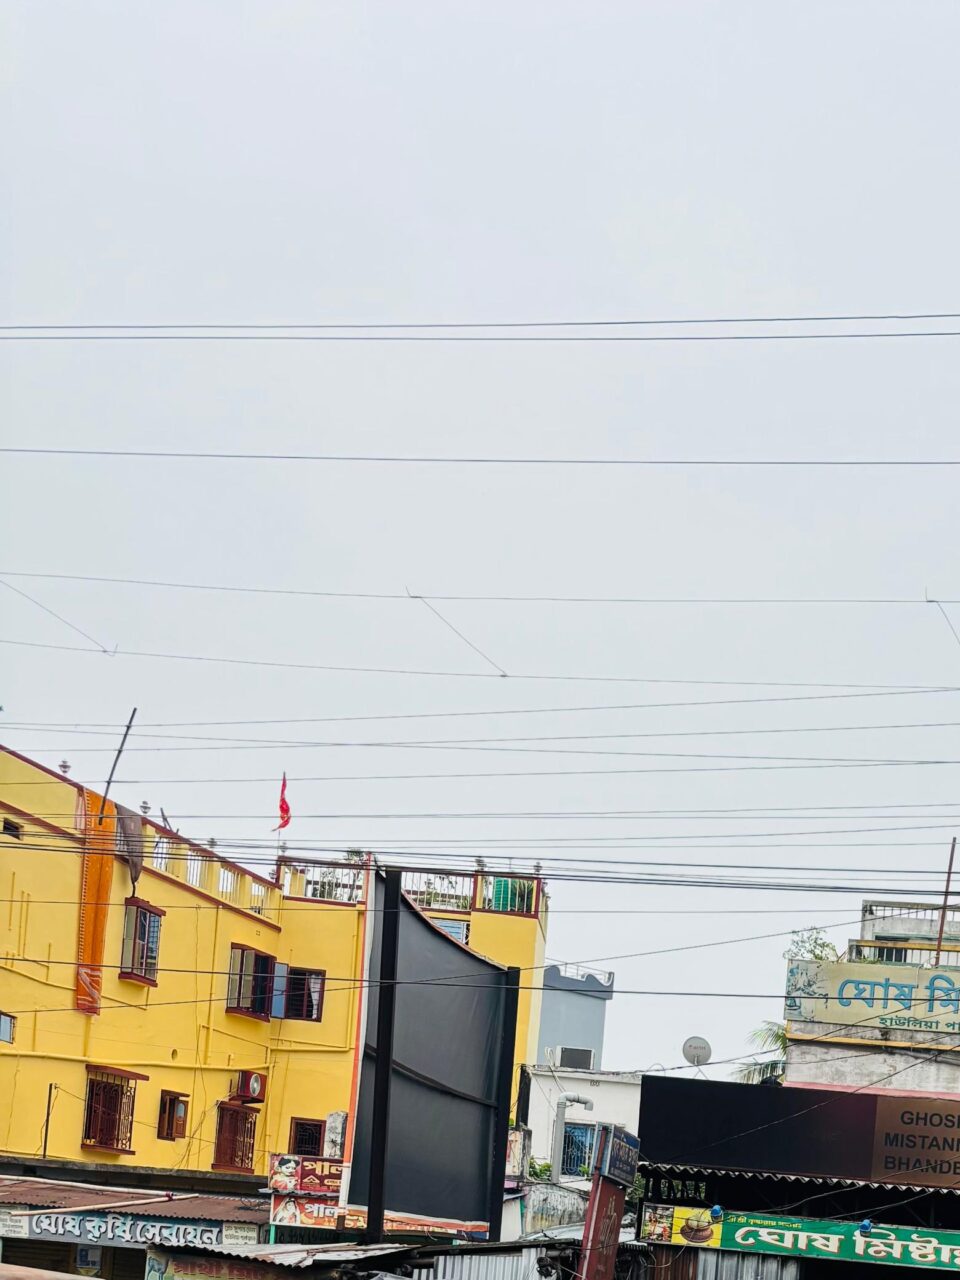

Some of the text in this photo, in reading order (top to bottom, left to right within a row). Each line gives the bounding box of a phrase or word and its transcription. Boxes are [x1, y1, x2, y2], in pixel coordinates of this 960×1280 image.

[837, 977, 918, 1011] ঘোষ
[31, 1213, 81, 1237] ঘোষ
[86, 1212, 134, 1242] কৃষি
[735, 1226, 845, 1253] ঘোষ
